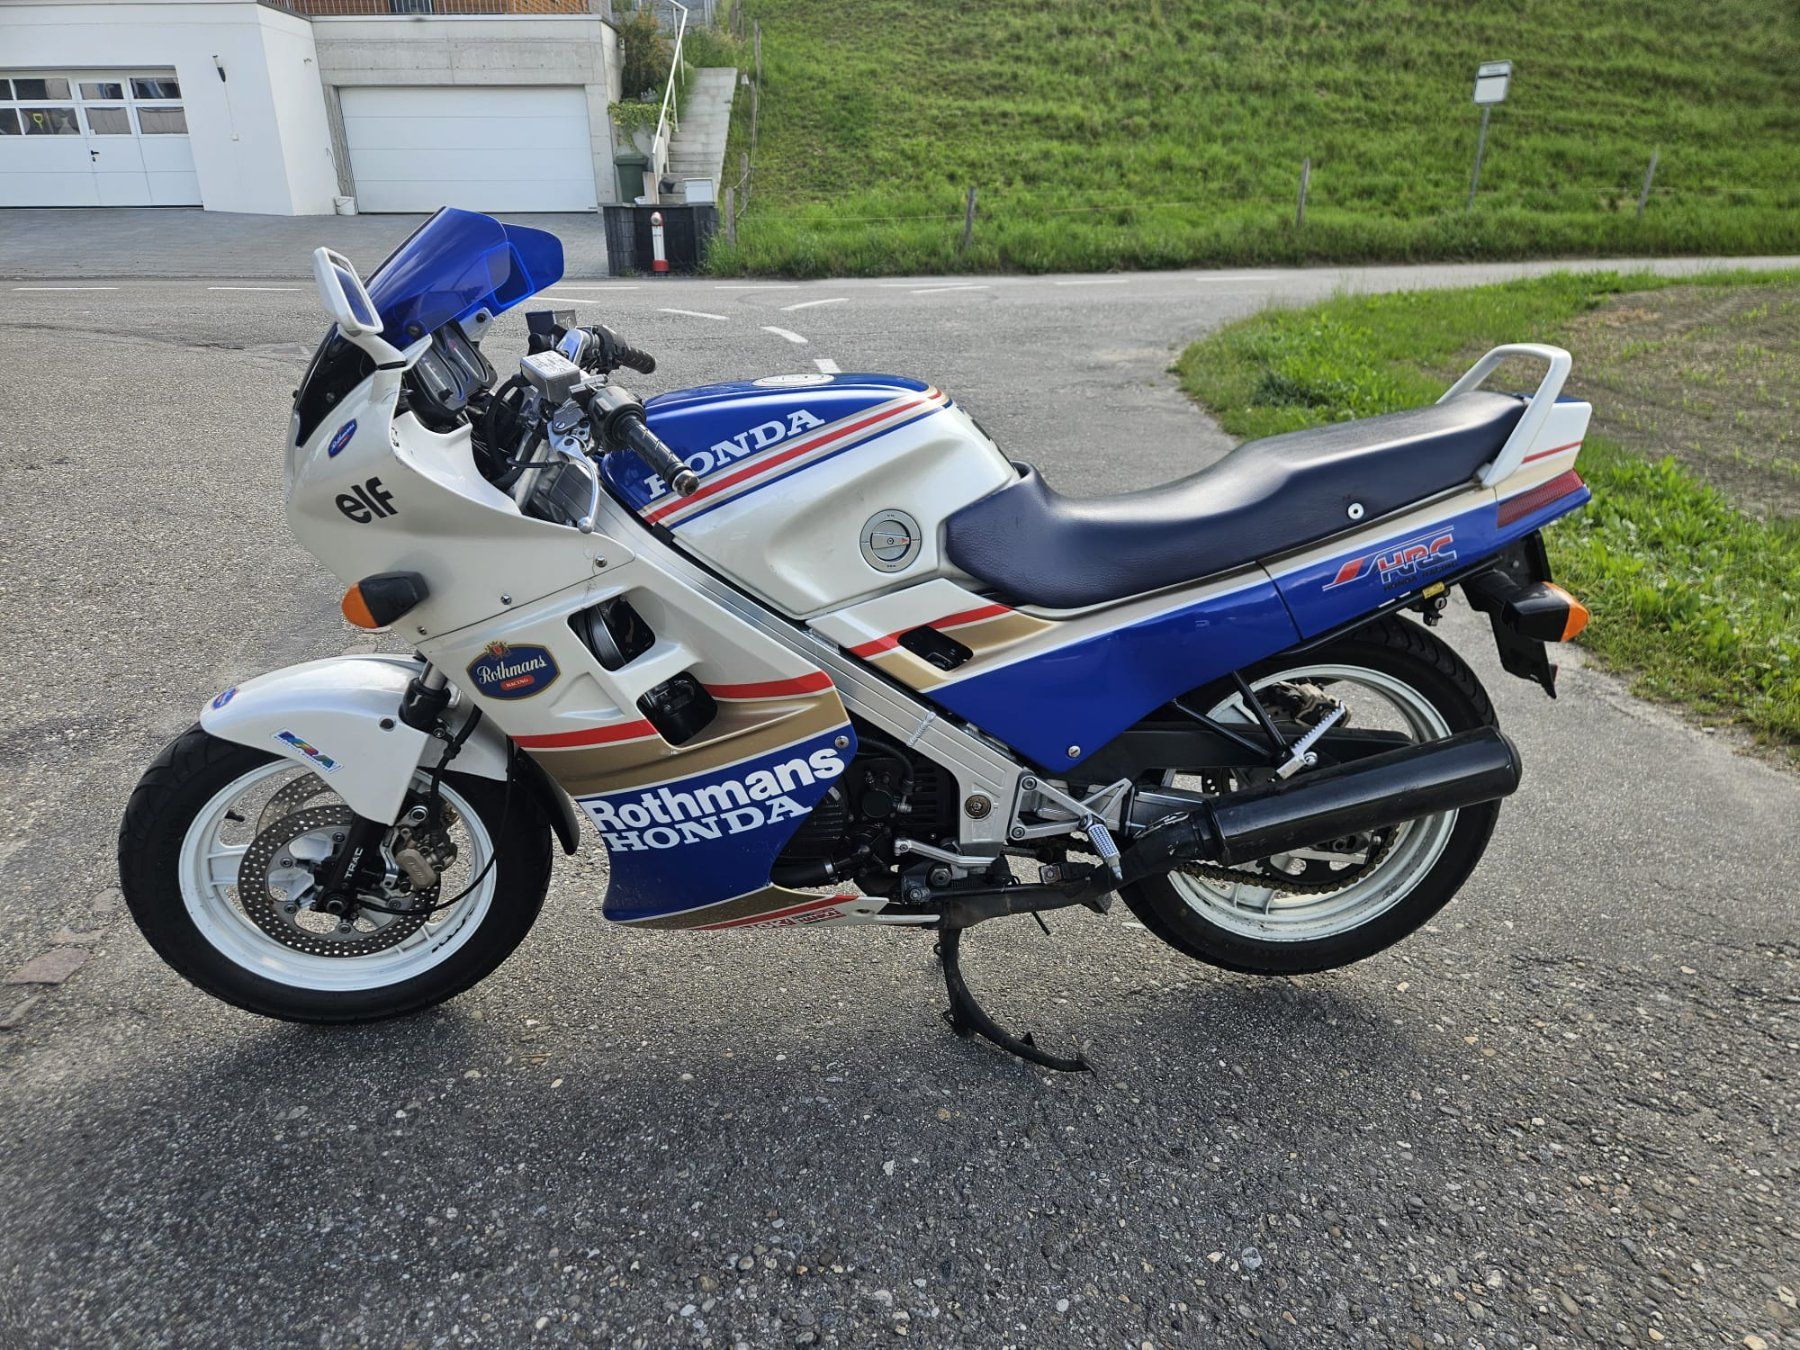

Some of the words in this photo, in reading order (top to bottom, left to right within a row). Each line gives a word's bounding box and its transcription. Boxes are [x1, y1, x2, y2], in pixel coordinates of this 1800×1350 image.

[335, 476, 398, 523] elf
[1378, 533, 1457, 584] HRC
[476, 655, 547, 684] Rothmans
[580, 748, 845, 831] Rothmans
[601, 795, 813, 852] HONDA
[344, 847, 364, 879] TRAC
